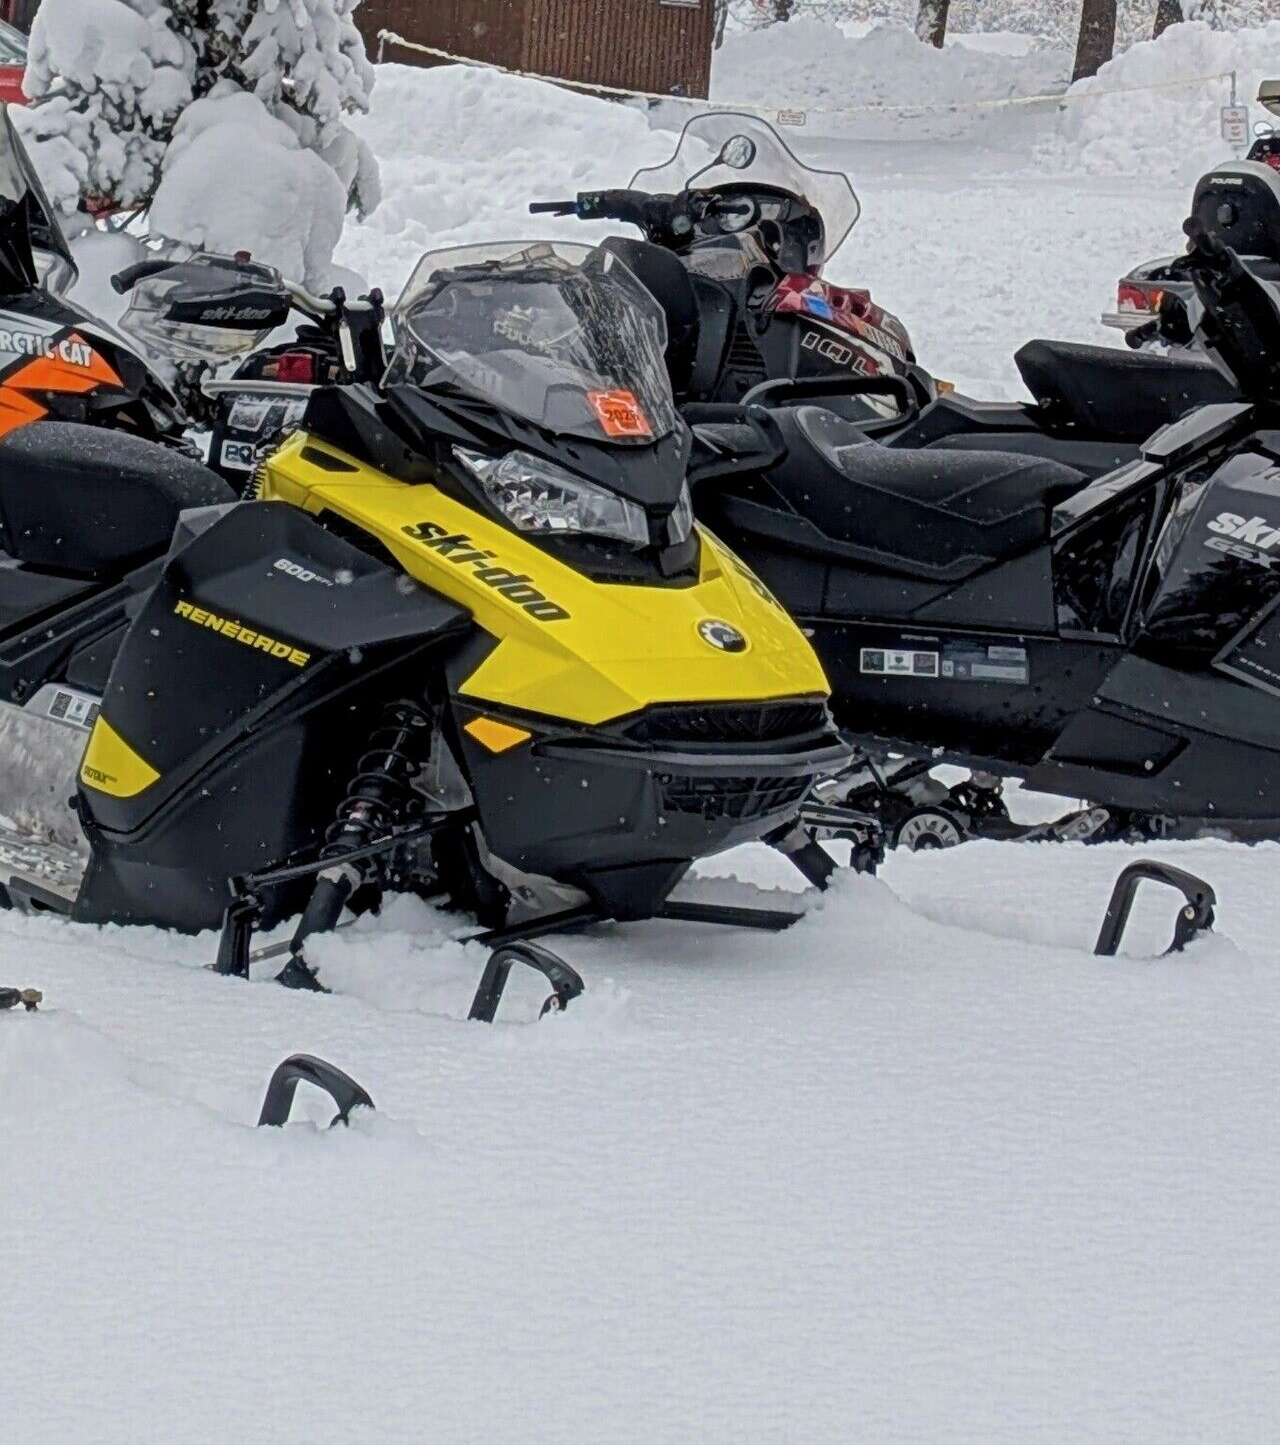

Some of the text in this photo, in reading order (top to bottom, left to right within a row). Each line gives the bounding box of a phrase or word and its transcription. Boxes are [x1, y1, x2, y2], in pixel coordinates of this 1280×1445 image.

[59, 339, 92, 368] CAT
[273, 558, 316, 583] 600
[400, 521, 572, 622] ski-doo
[174, 599, 311, 667] RENEGADE
